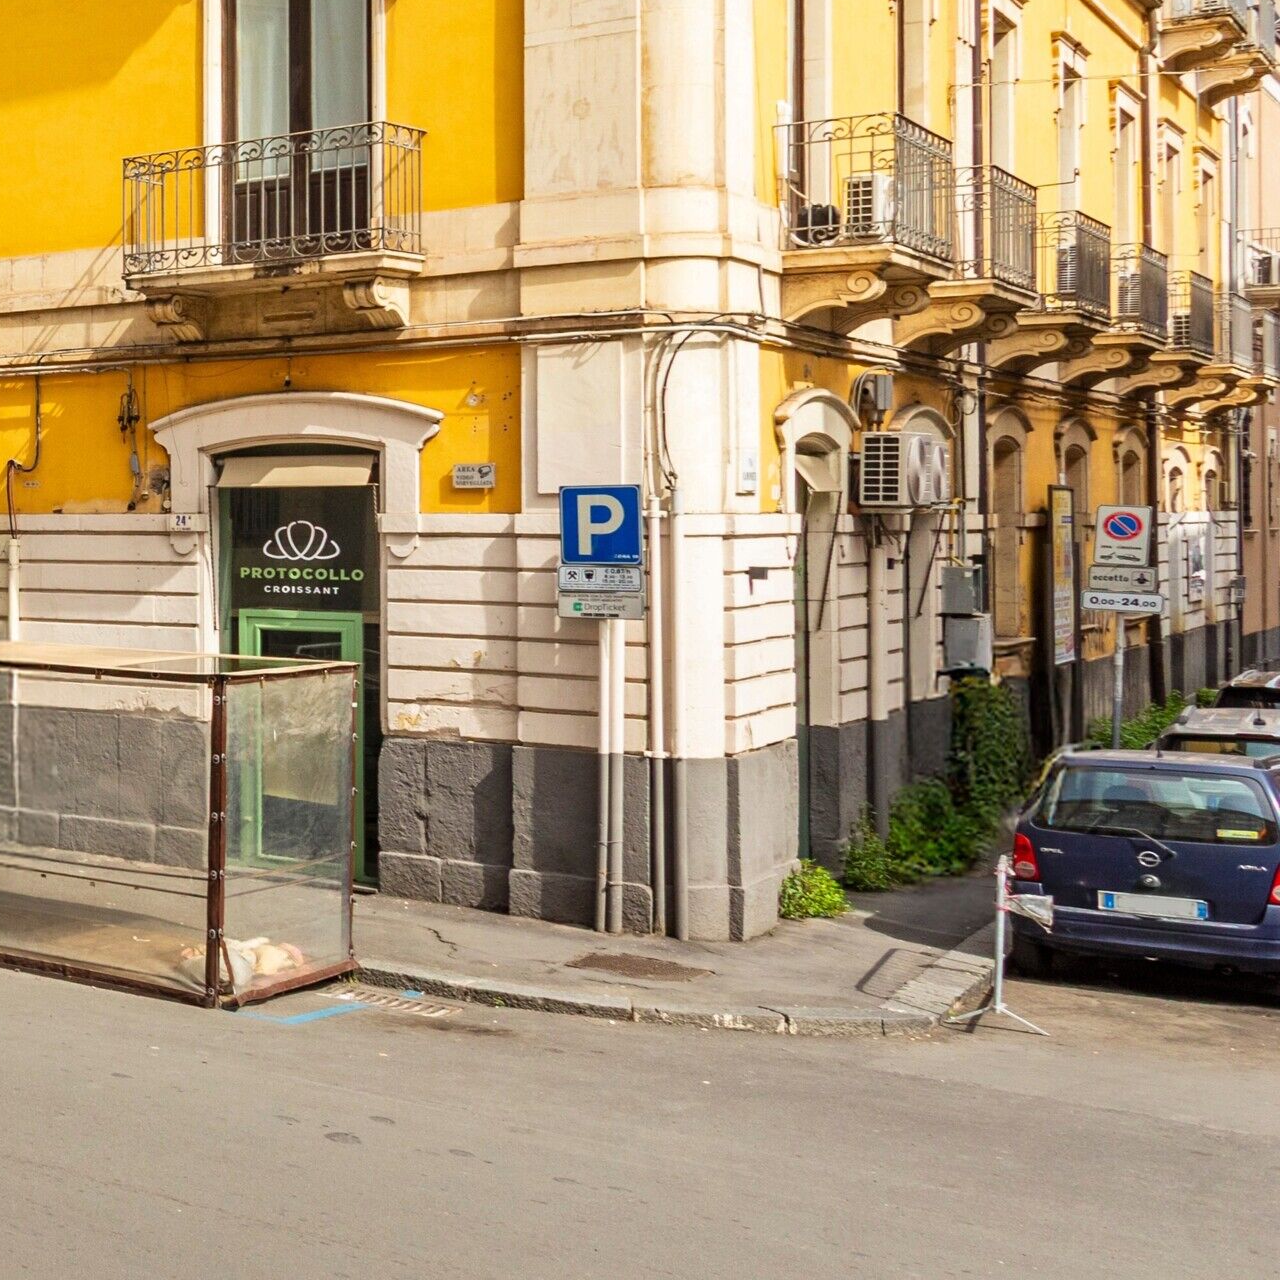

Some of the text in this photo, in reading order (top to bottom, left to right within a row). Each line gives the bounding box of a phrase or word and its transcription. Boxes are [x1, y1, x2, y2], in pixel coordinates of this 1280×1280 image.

[576, 494, 625, 556] P
[240, 567, 364, 581] PROTOCOLLO
[1092, 575, 1130, 583] eccetto
[264, 585, 340, 595] CROISSANT
[584, 603, 626, 612] DropTicket
